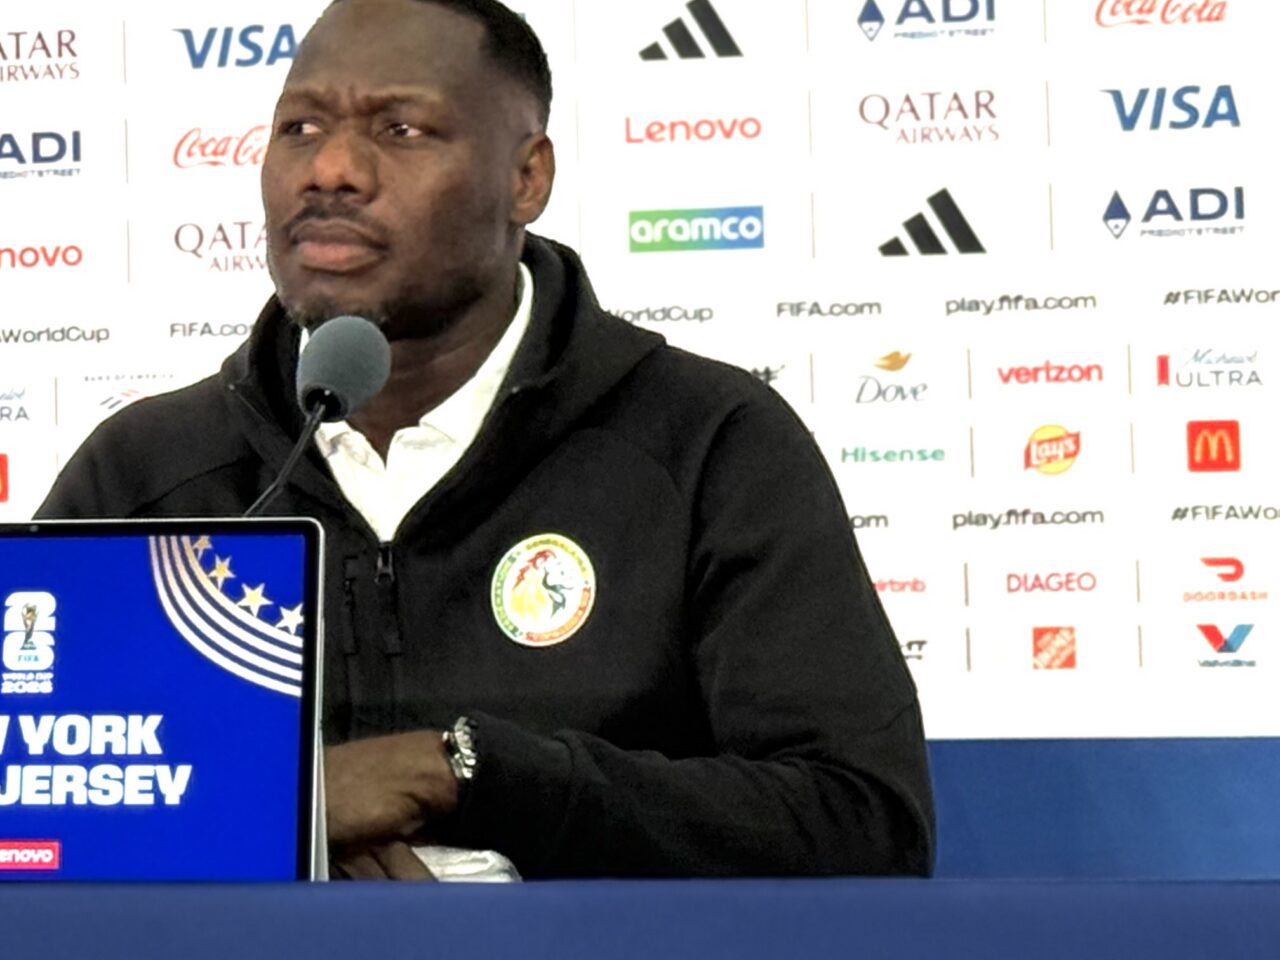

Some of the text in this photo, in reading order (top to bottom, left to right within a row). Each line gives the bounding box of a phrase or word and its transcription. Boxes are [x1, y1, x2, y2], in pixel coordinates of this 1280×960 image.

[171, 24, 298, 69] VISA
[858, 89, 997, 127] QATAR
[1104, 84, 1241, 132] VISA
[624, 116, 762, 144] Lenovo
[897, 124, 1000, 145] AIRWAYS
[1141, 186, 1245, 223] ADI
[174, 222, 267, 257] QATA
[631, 215, 761, 242] aramco
[210, 255, 267, 272] AIRW
[776, 301, 882, 318] FIFA.com
[945, 294, 1097, 317] play.fifa.com
[1163, 288, 1280, 305] #FIFAWor
[997, 359, 1104, 385] verizon
[1175, 369, 1263, 388] ULTRA
[855, 375, 928, 404] Dove
[840, 446, 946, 464] Hisense
[951, 508, 1105, 531] play.fifa.com
[1006, 571, 1097, 594] DIAGEO
[18, 715, 163, 755] YORK
